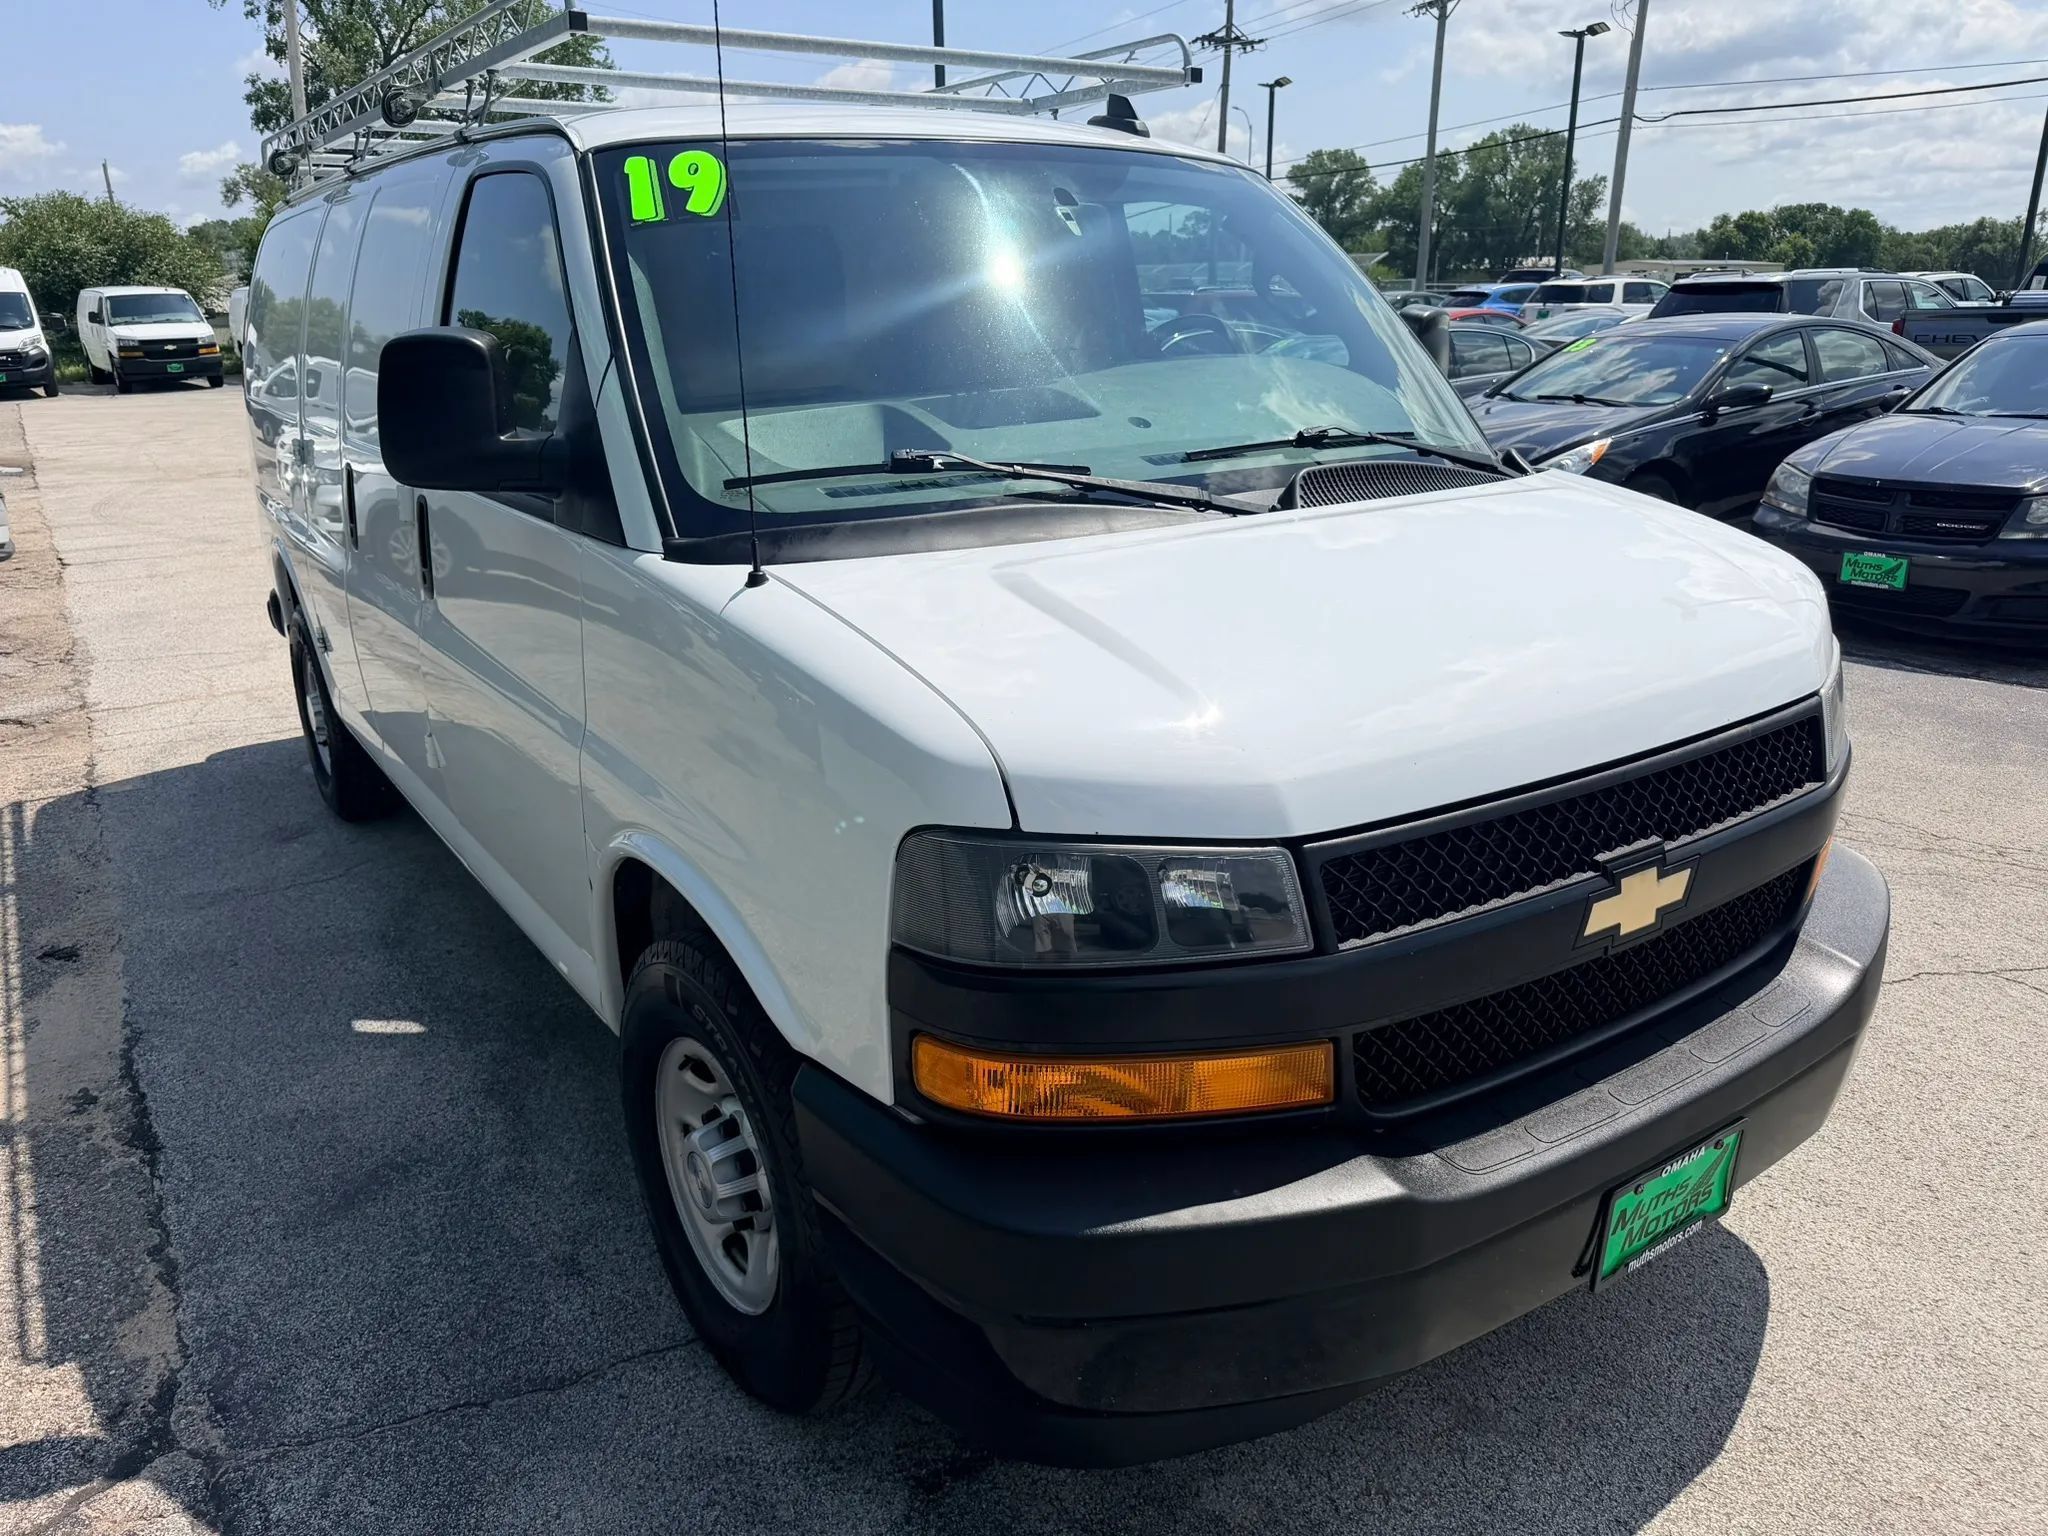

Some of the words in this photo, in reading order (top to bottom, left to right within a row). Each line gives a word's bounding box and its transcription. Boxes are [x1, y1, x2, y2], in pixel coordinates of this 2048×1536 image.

[624, 150, 727, 222] 19
[1845, 557, 1884, 571] MUTHS
[1850, 567, 1899, 582] MOTORS
[1661, 1146, 1706, 1178] OMAHA
[1611, 1176, 1692, 1236] MUTHS
[1621, 1180, 1715, 1251] MOTORS
[1627, 1220, 1703, 1273] muthsmotors.com
